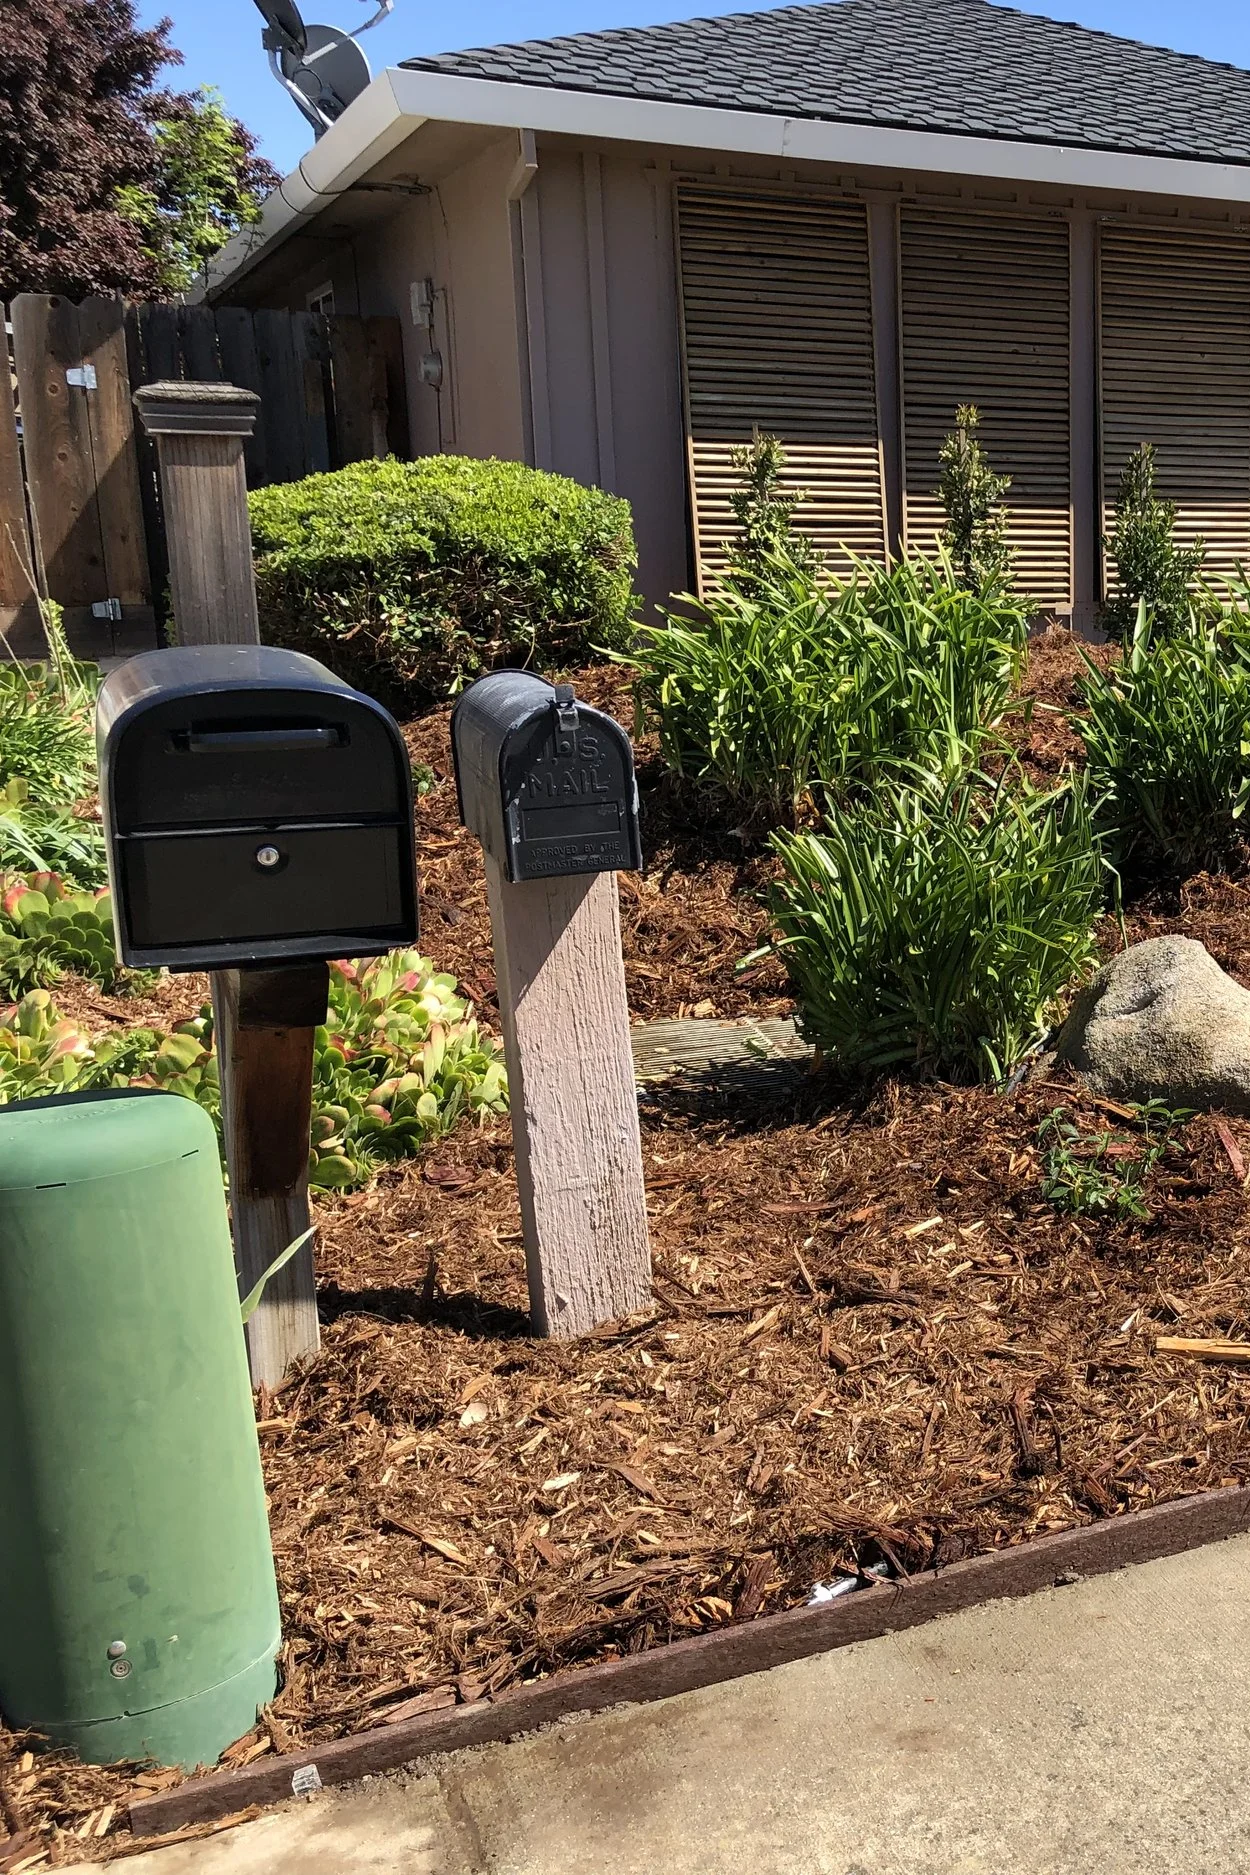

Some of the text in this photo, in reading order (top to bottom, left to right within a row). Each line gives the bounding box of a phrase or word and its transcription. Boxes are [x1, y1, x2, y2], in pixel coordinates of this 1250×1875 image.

[528, 769, 610, 799] MAIL
[531, 840, 621, 858] APPROVED BY THE
[525, 854, 626, 871] POSTMASTER GENERAL
